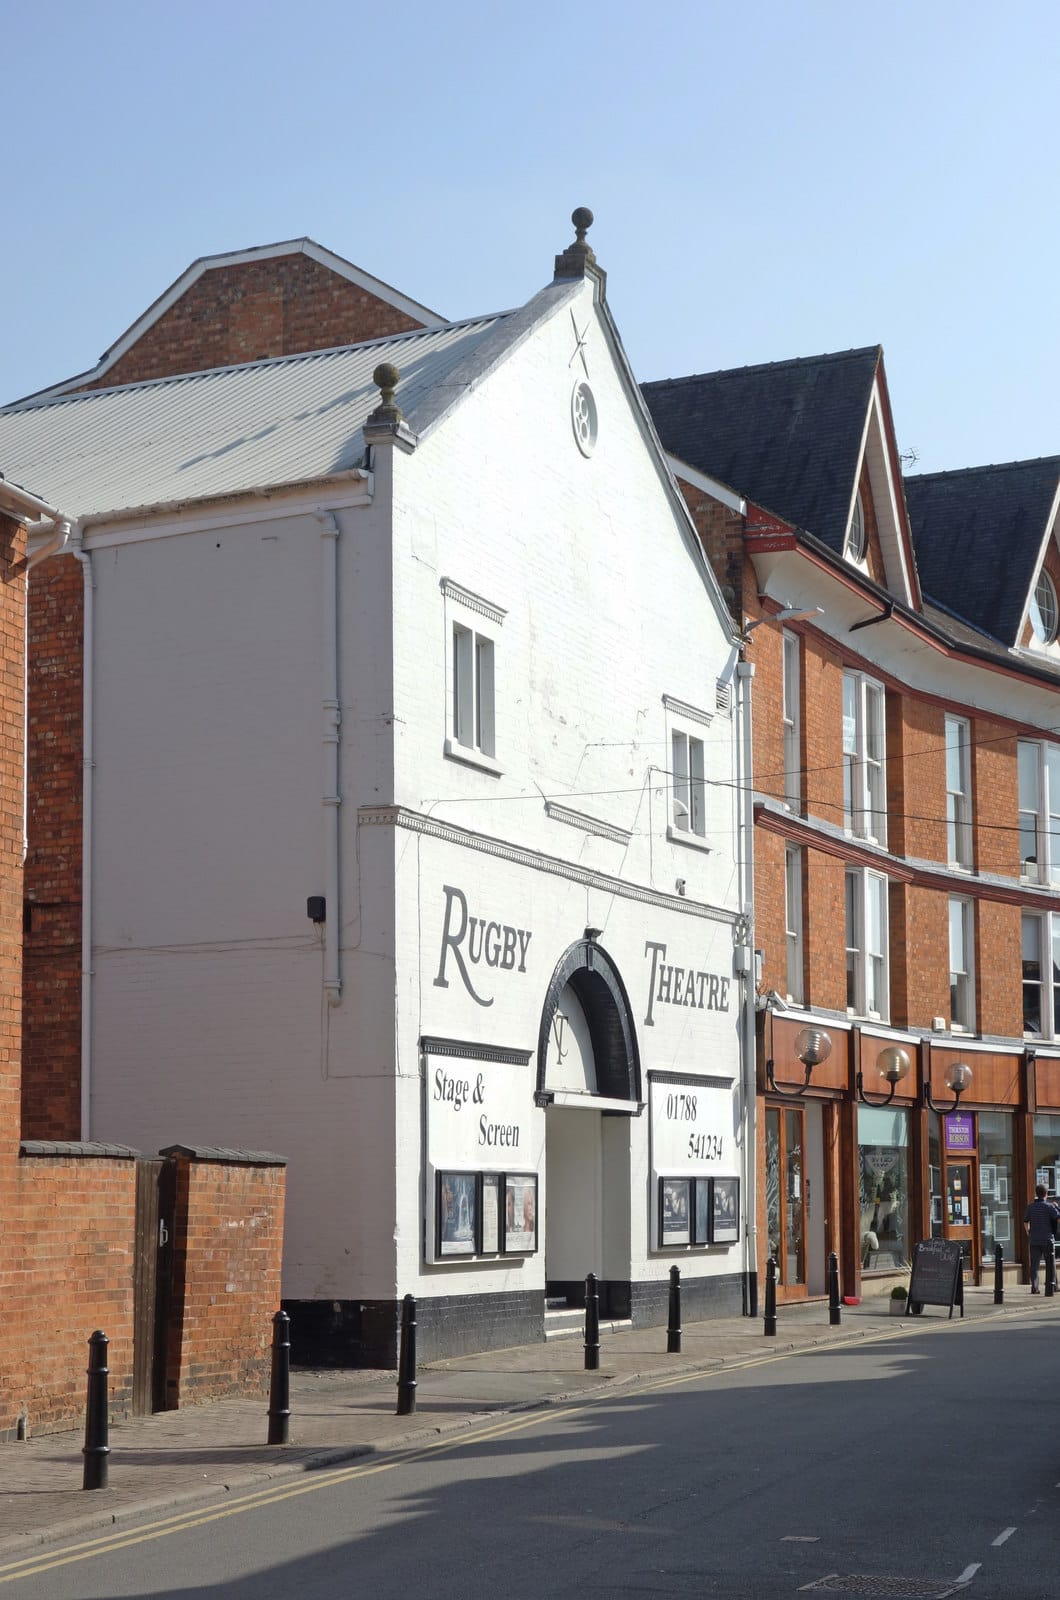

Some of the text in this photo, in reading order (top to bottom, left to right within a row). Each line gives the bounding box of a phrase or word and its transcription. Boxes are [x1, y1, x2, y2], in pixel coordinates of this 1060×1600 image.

[433, 1068, 485, 1111] Stage &
[667, 1093, 697, 1121] 01788
[478, 1114, 519, 1148] Screen
[687, 1133, 722, 1161] 541234
